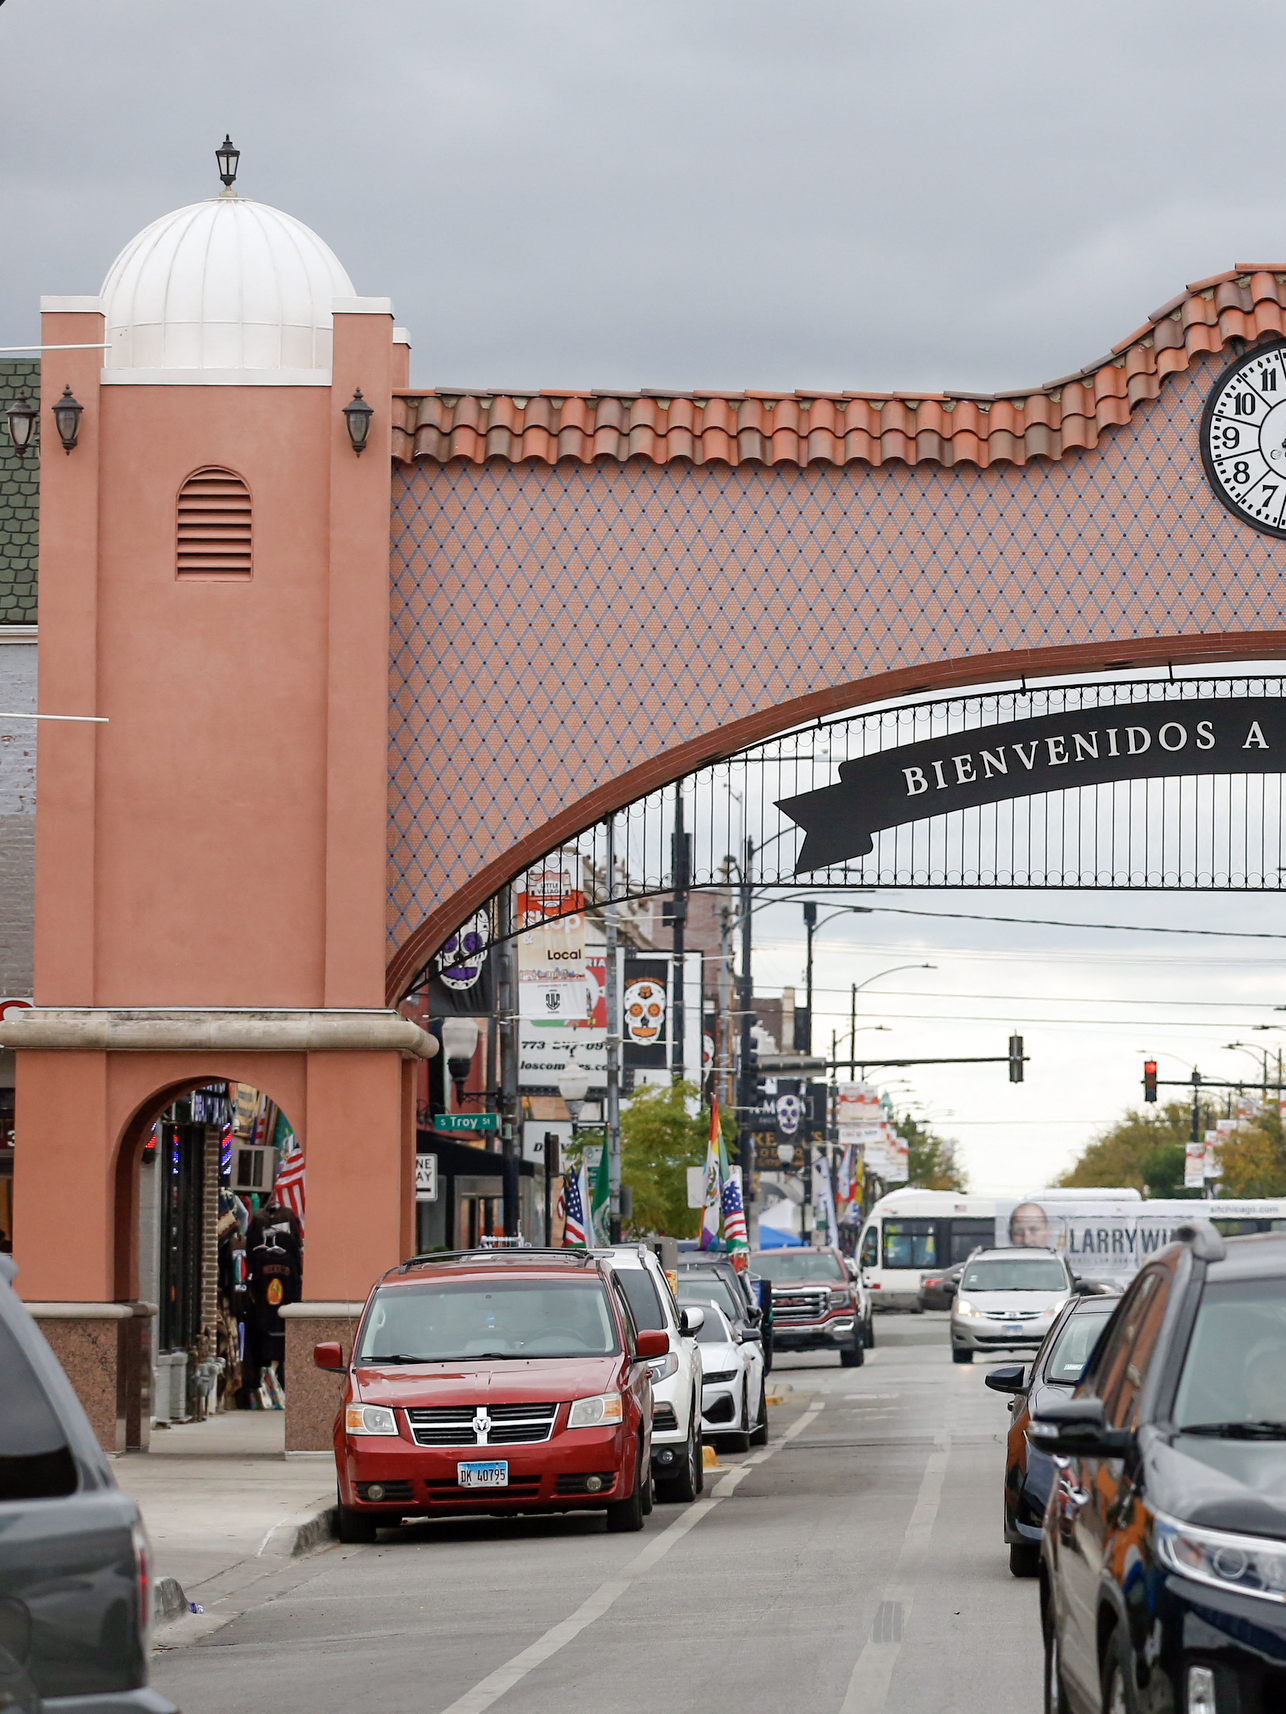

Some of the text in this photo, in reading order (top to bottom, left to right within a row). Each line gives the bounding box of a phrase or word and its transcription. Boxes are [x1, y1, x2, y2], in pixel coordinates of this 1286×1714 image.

[1260, 367, 1277, 392] 11
[1233, 392, 1256, 416] 10
[1222, 426, 1240, 449] 9
[1232, 461, 1251, 484] 8
[1262, 484, 1280, 508] 7
[902, 720, 1217, 797] BIENVENIDOS
[1241, 721, 1270, 749] A
[522, 910, 581, 934] Shop
[547, 949, 582, 961] Local
[450, 1116, 478, 1129] Troy
[482, 1117, 491, 1126] St
[416, 1159, 431, 1169] NE
[416, 1171, 432, 1181] AY
[460, 1468, 506, 1483] DK 40795
